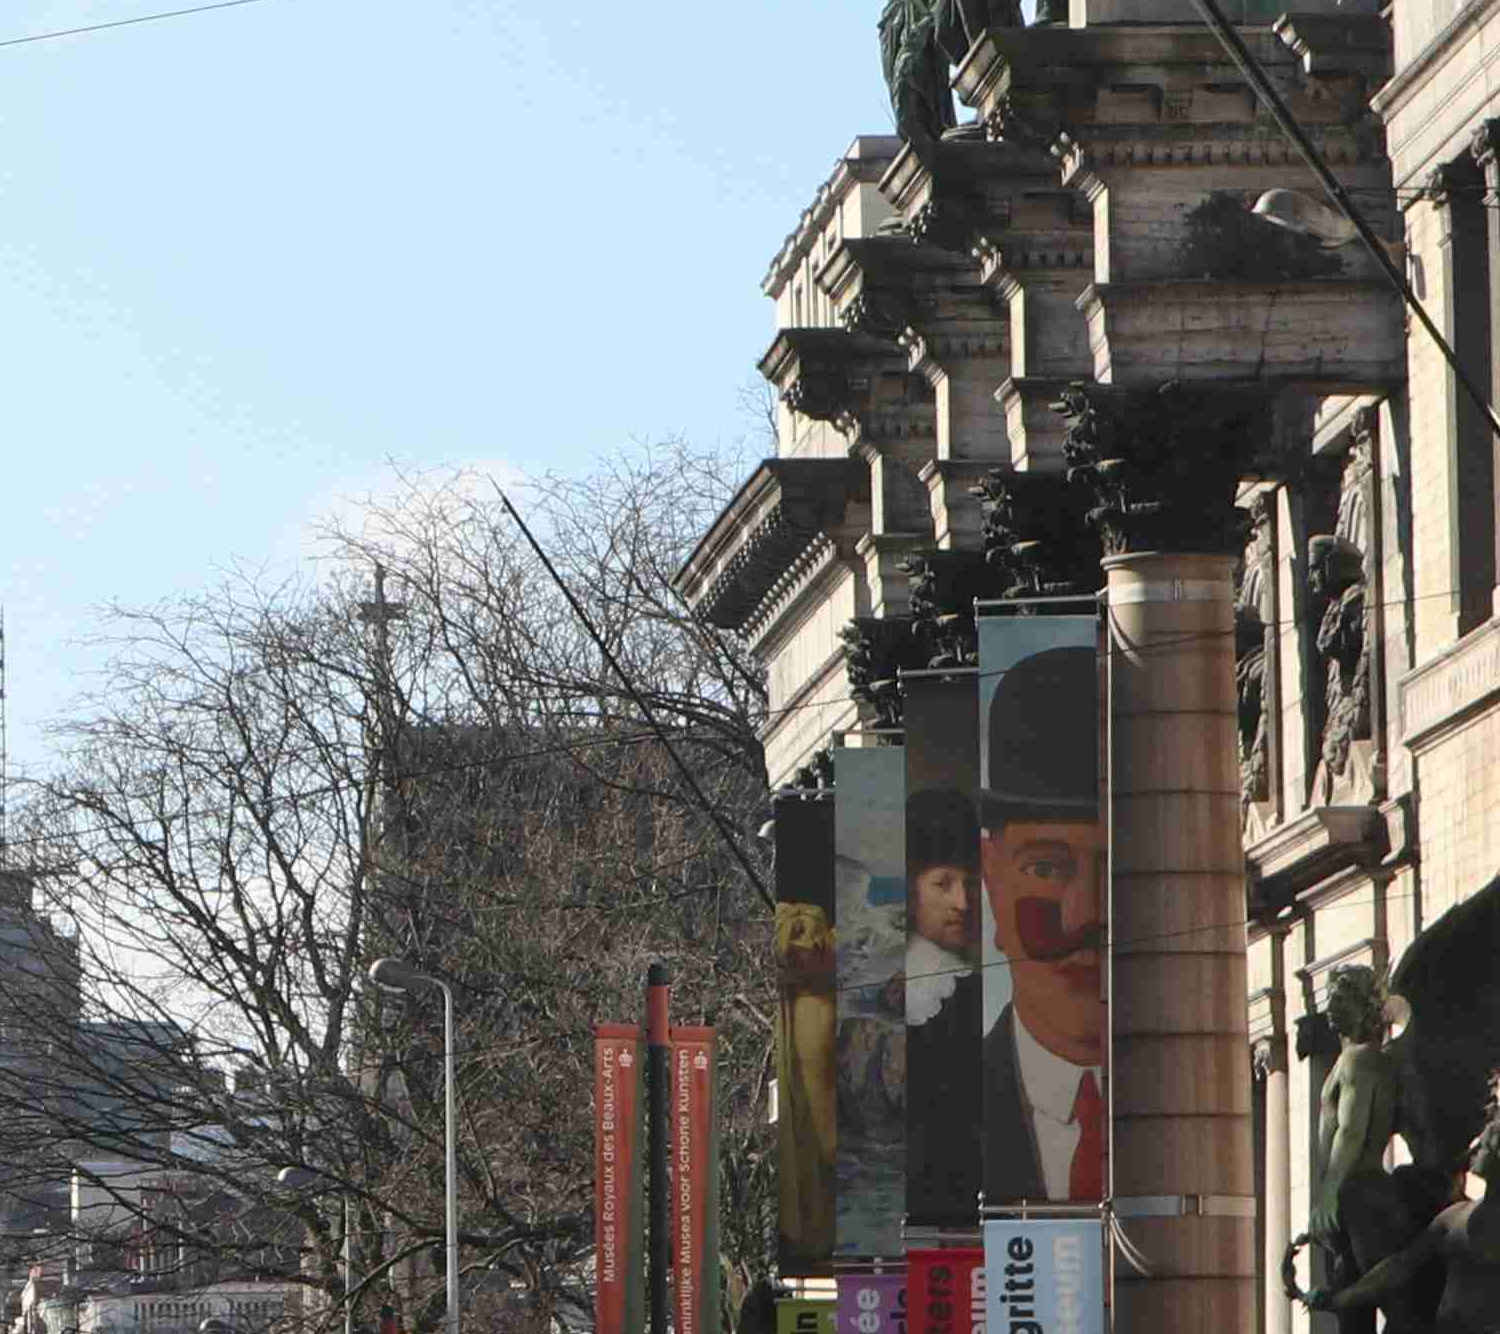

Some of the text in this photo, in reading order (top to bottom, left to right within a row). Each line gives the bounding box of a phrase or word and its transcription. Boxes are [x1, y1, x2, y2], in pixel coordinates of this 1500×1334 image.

[602, 1047, 614, 1131] Beaux-Arts
[678, 1049, 690, 1112] Kunsten
[603, 1135, 614, 1162] des
[679, 1116, 691, 1172] Schone
[603, 1165, 617, 1220] Royaux
[680, 1178, 691, 1211] voor
[680, 1215, 691, 1264] Musea
